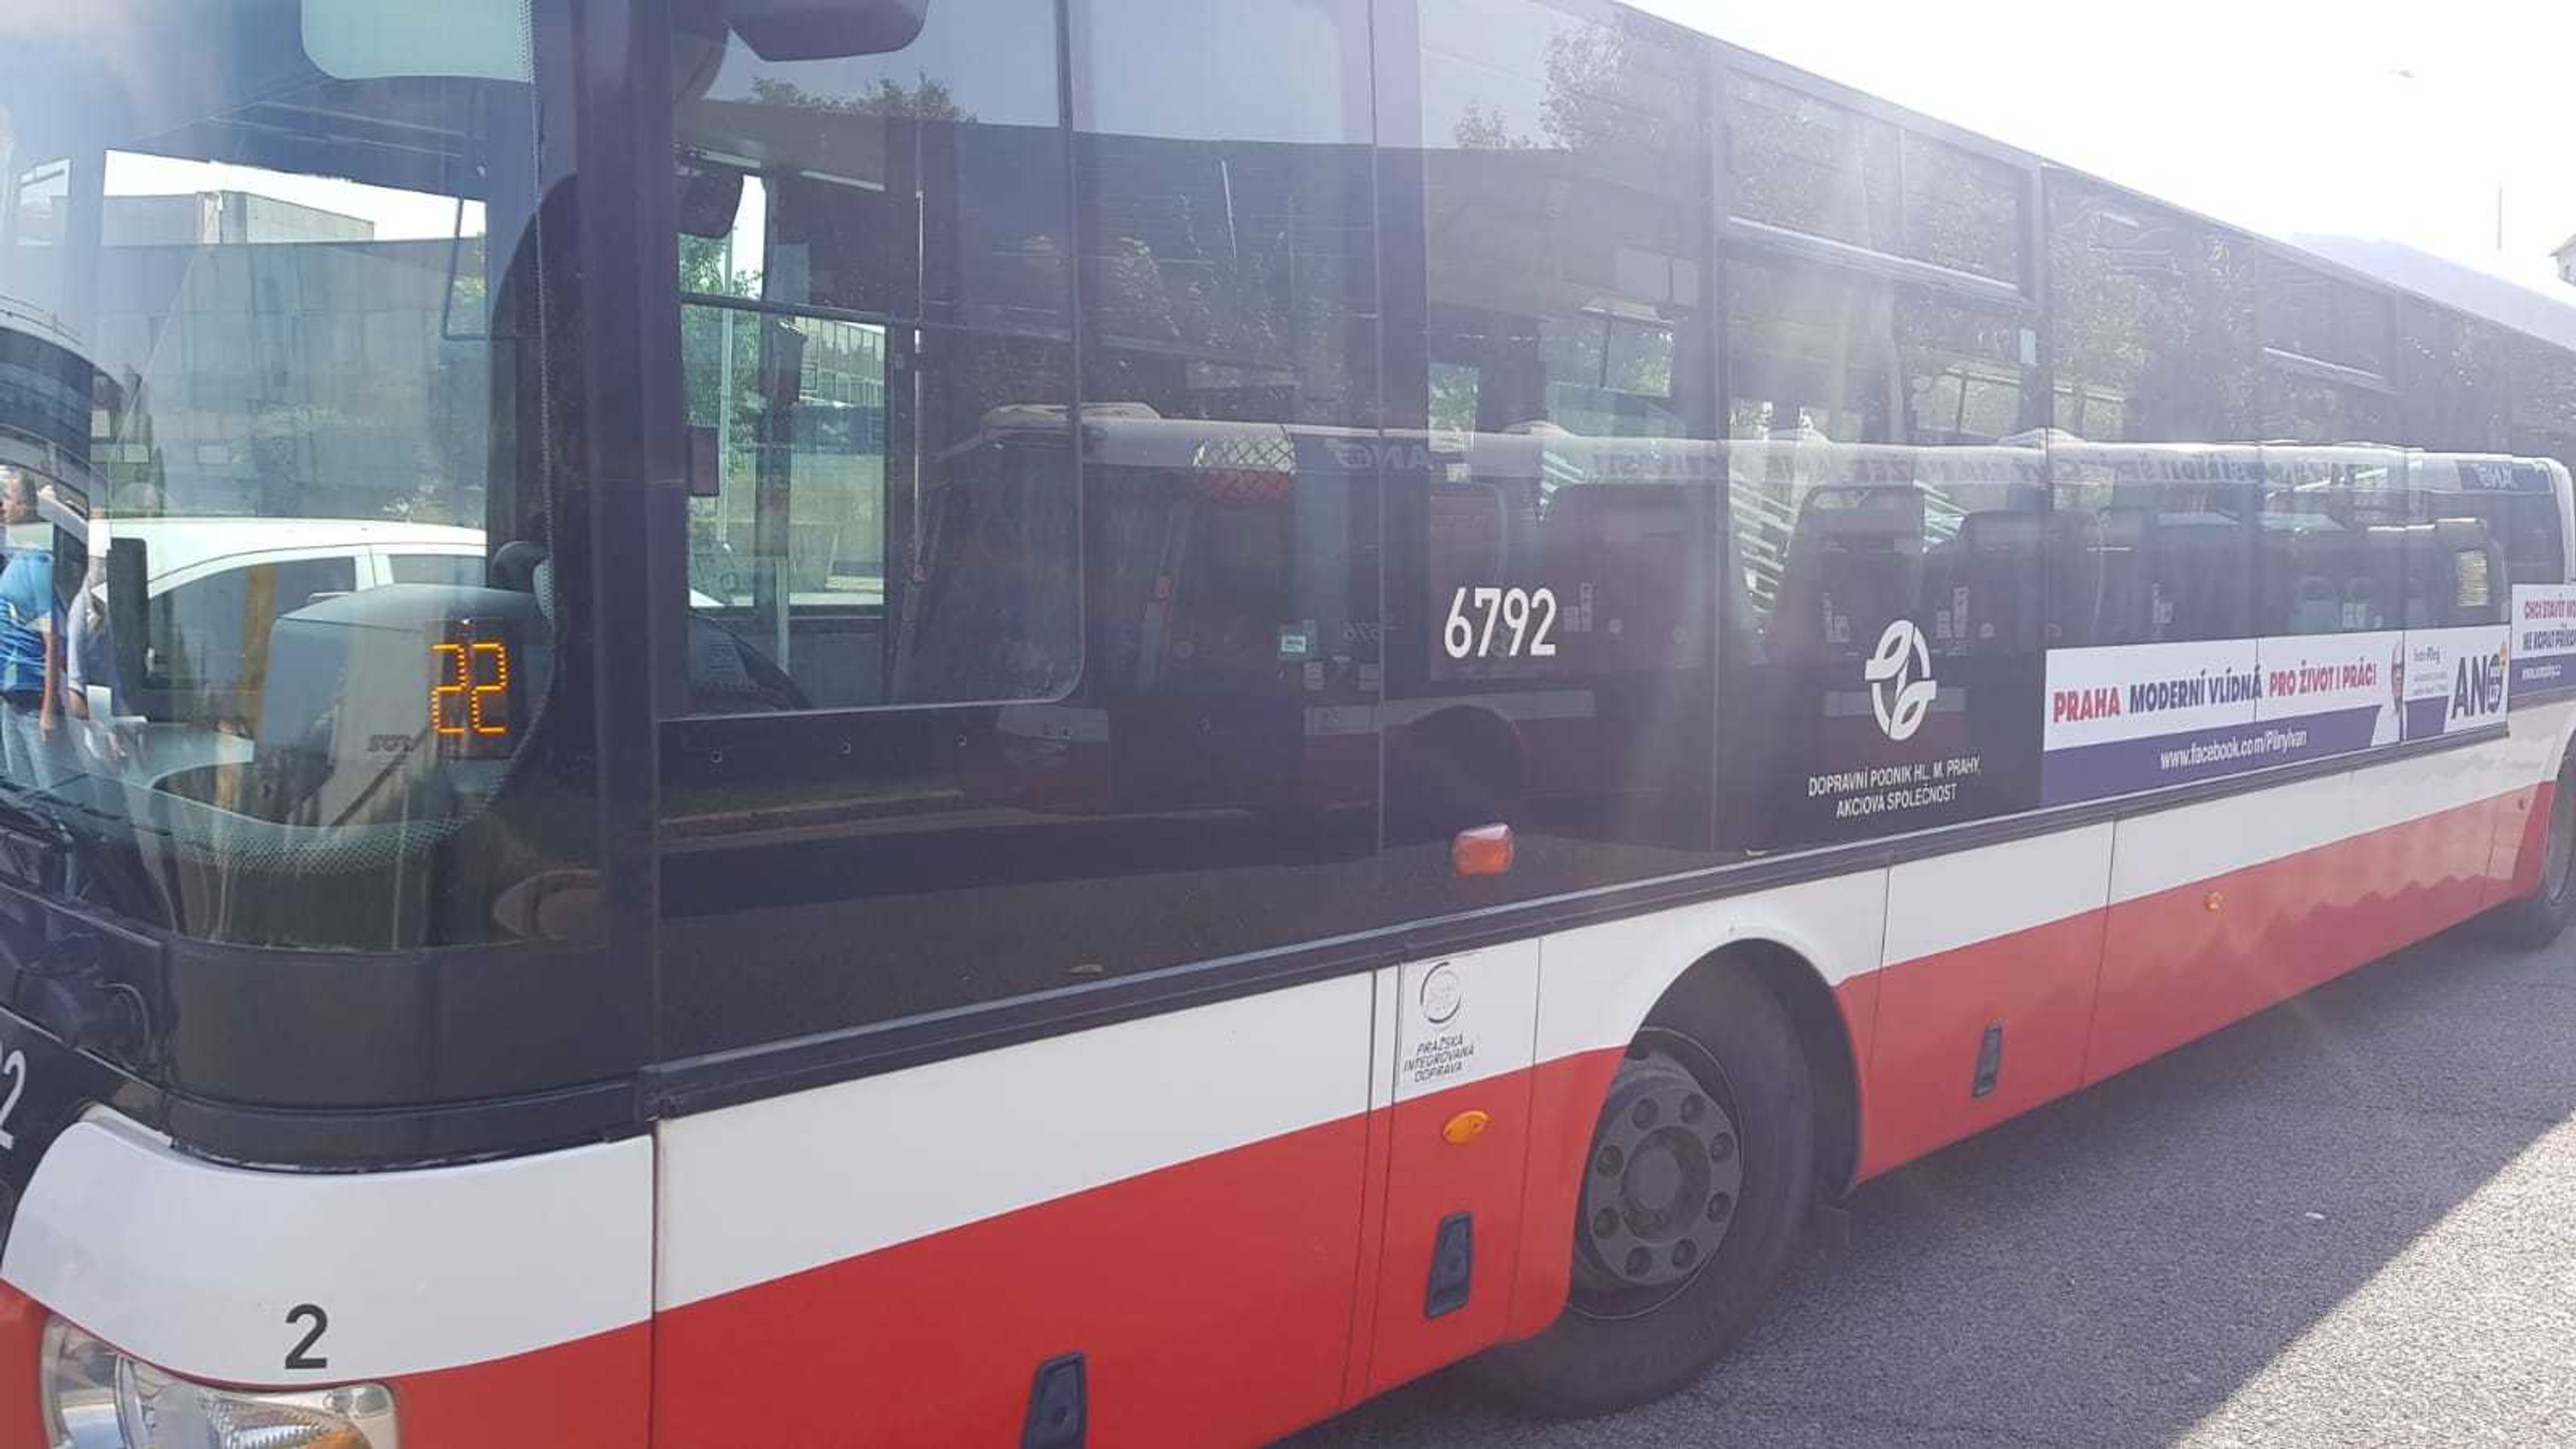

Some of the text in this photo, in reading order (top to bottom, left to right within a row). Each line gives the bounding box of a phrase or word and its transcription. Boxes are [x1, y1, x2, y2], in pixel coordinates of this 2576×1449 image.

[1443, 586, 1557, 659] 6792
[429, 641, 510, 736] 22
[2053, 686, 2122, 723] PRAHA
[2129, 669, 2205, 714] MODERNÍ
[2208, 664, 2263, 704] VLÍDNÁ
[2269, 671, 2296, 697] PRO
[2298, 660, 2334, 694] ŽIVOT
[2336, 668, 2341, 690] I
[2451, 654, 2504, 720] ANO
[1808, 766, 1868, 797] DOPRAVNÍ
[1870, 764, 1913, 787] PODNIK
[1932, 760, 1944, 779] M.
[1887, 783, 1957, 811] SPOLEČNOST
[0, 1040, 26, 1150] 2
[284, 1303, 328, 1370] 2
